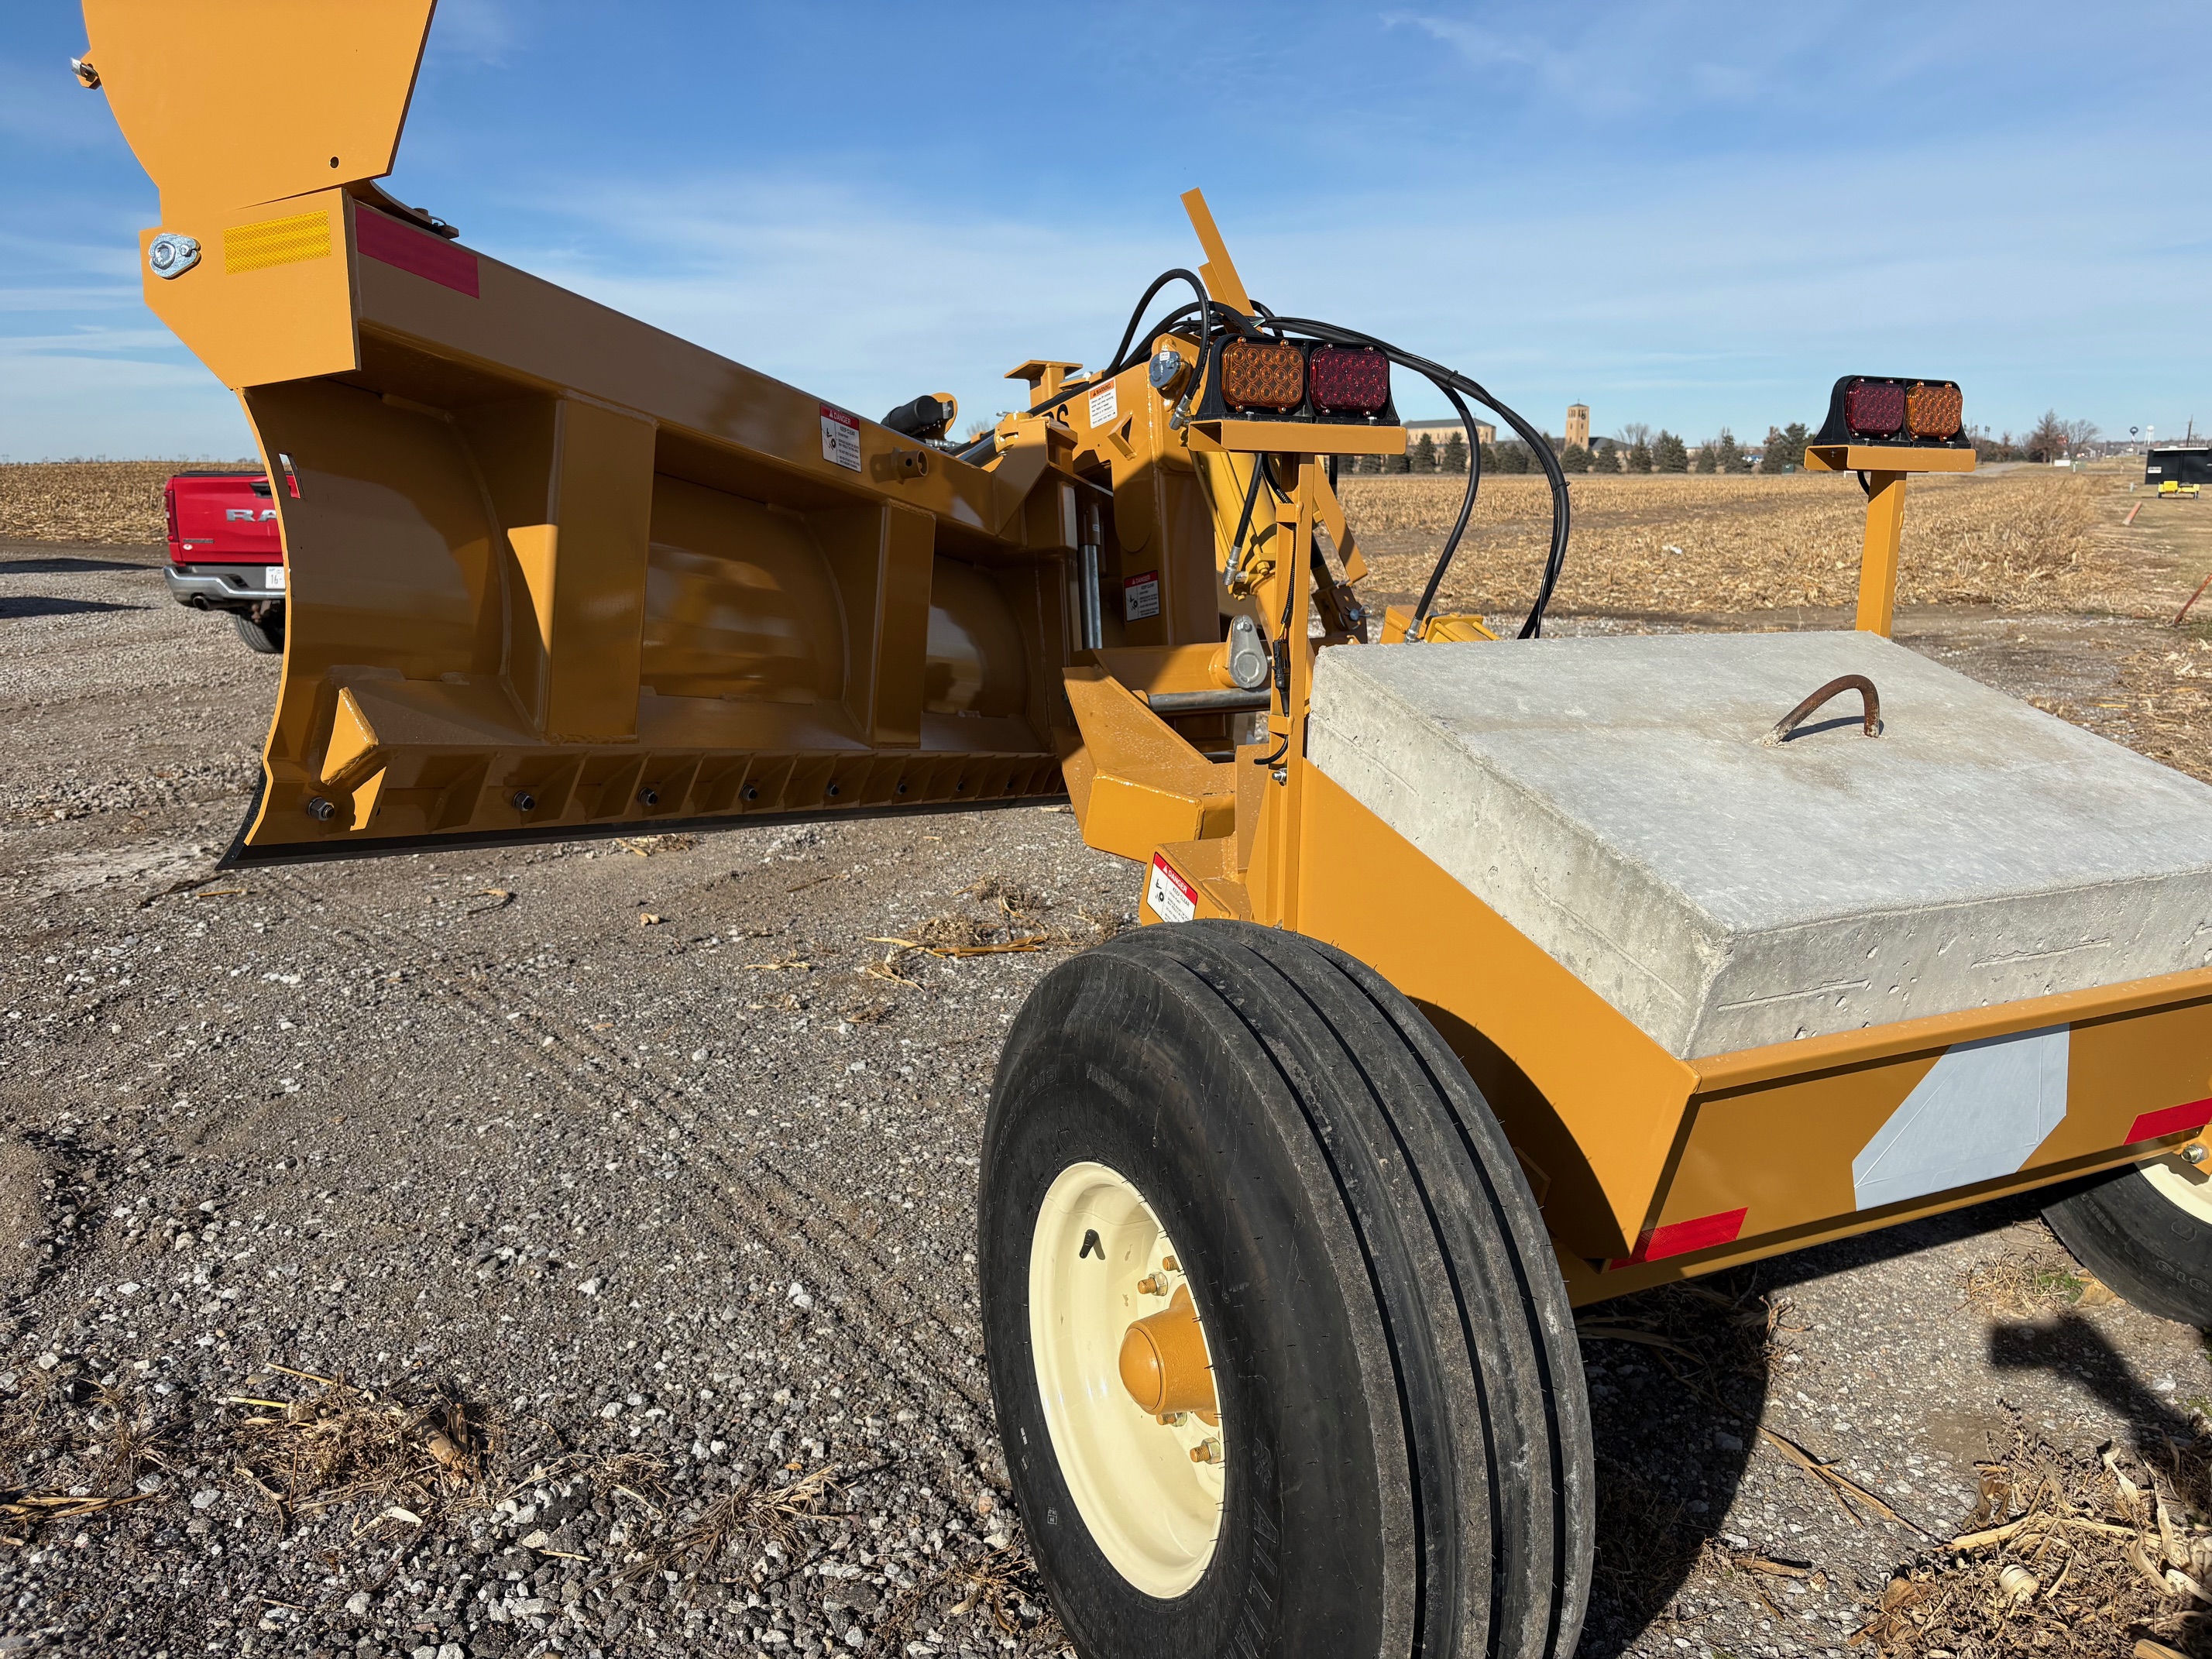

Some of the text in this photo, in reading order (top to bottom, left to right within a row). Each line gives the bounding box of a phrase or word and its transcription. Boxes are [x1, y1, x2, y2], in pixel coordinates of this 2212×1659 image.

[1096, 383, 1111, 394] WARNING
[833, 412, 851, 425] DANGER
[226, 509, 277, 522] RA
[1168, 870, 1187, 894] DANGER
